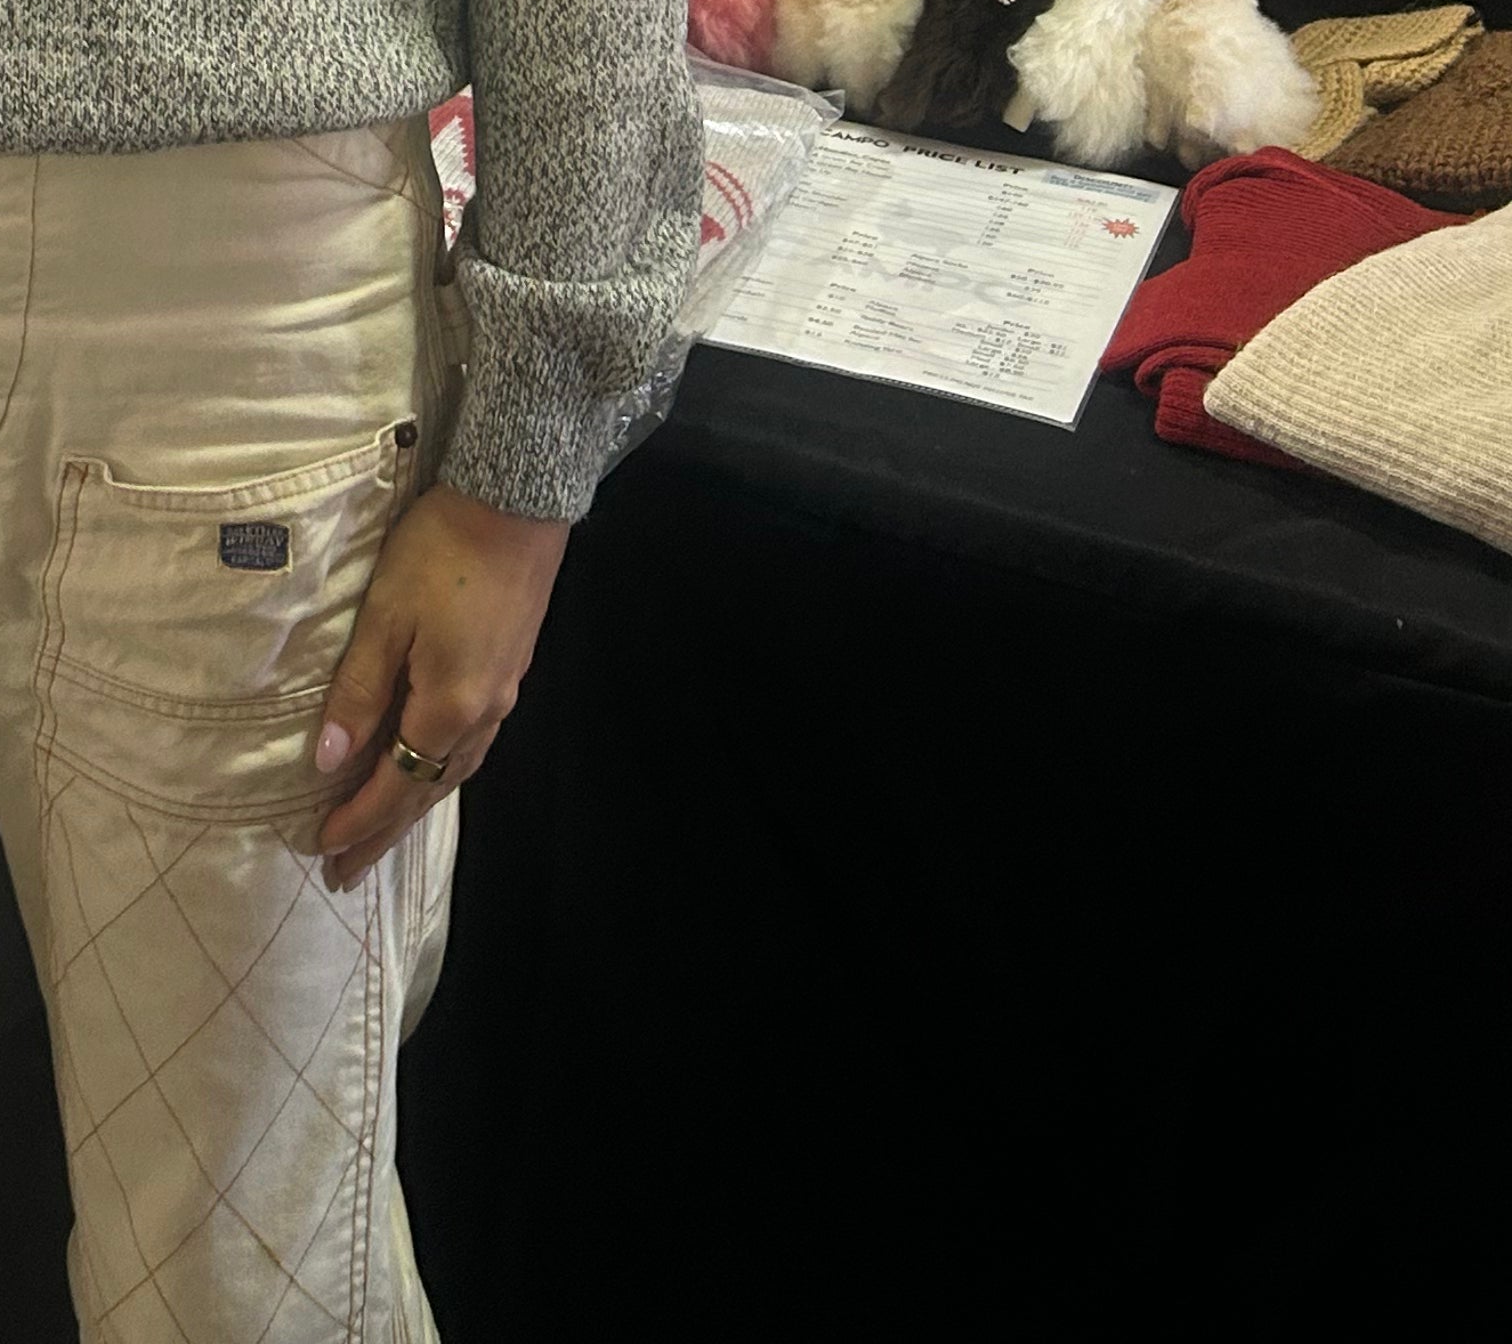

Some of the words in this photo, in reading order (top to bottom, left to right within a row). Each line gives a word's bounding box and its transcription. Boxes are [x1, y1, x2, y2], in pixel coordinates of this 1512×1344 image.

[820, 129, 889, 147] CAMPO
[903, 145, 967, 165] PRICE
[975, 159, 1024, 175] LIST
